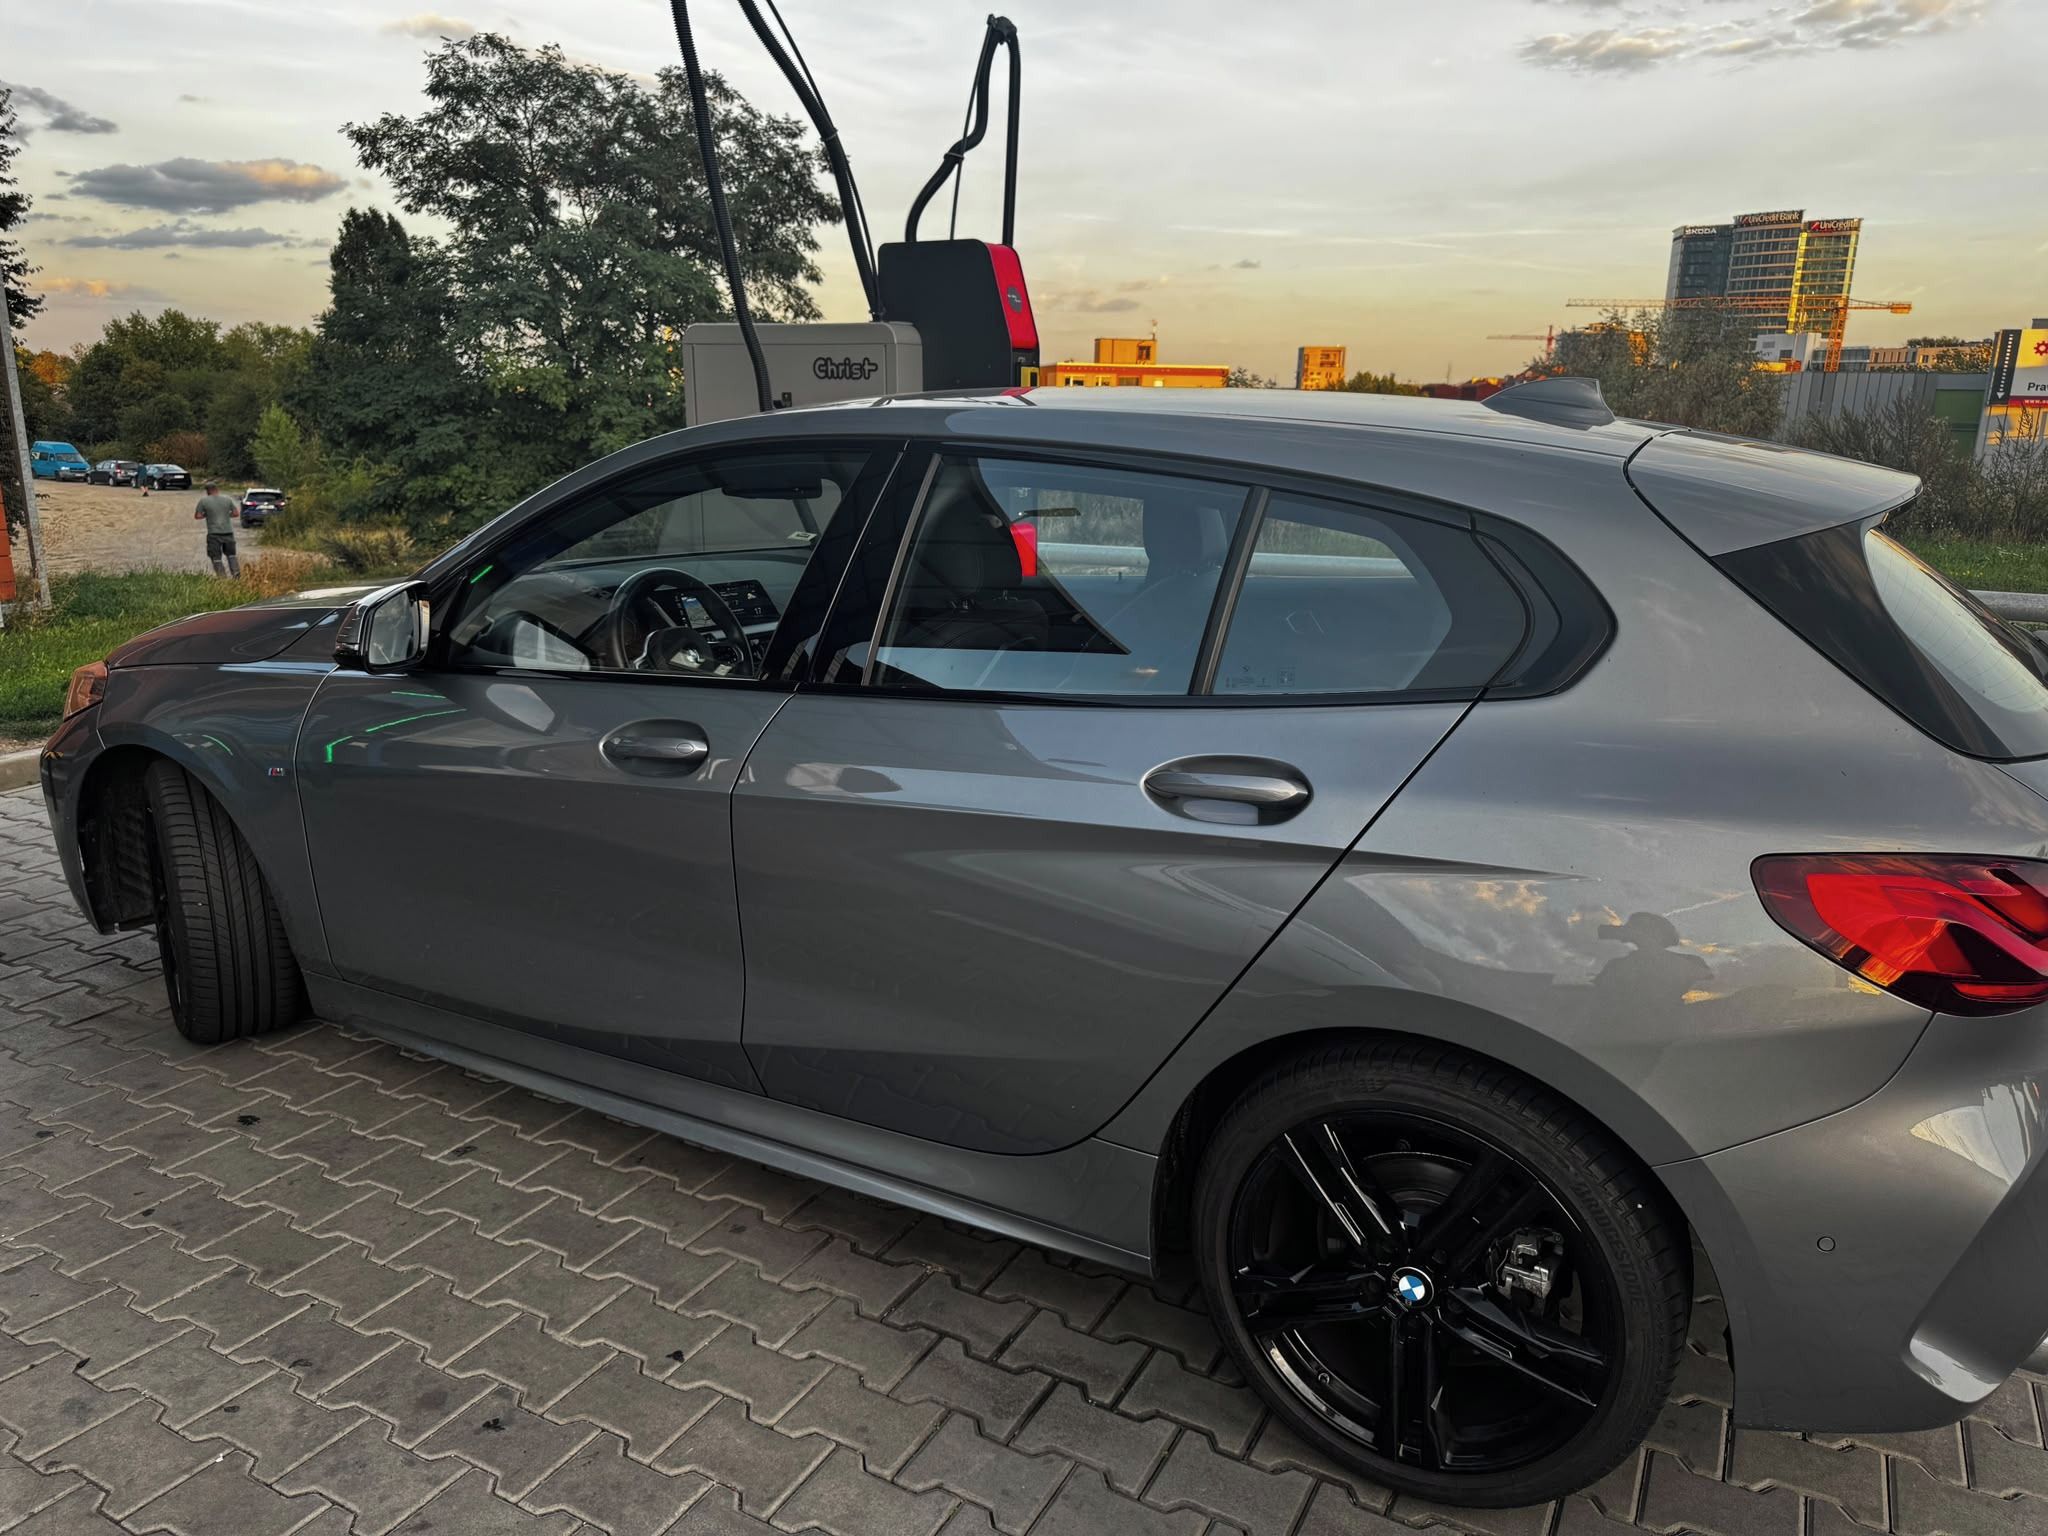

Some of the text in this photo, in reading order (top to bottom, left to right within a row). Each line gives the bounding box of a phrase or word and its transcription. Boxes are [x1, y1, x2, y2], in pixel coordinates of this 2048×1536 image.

[1779, 212, 1800, 221] Bank
[813, 356, 878, 380] Christ
[2027, 382, 2048, 392] Pra
